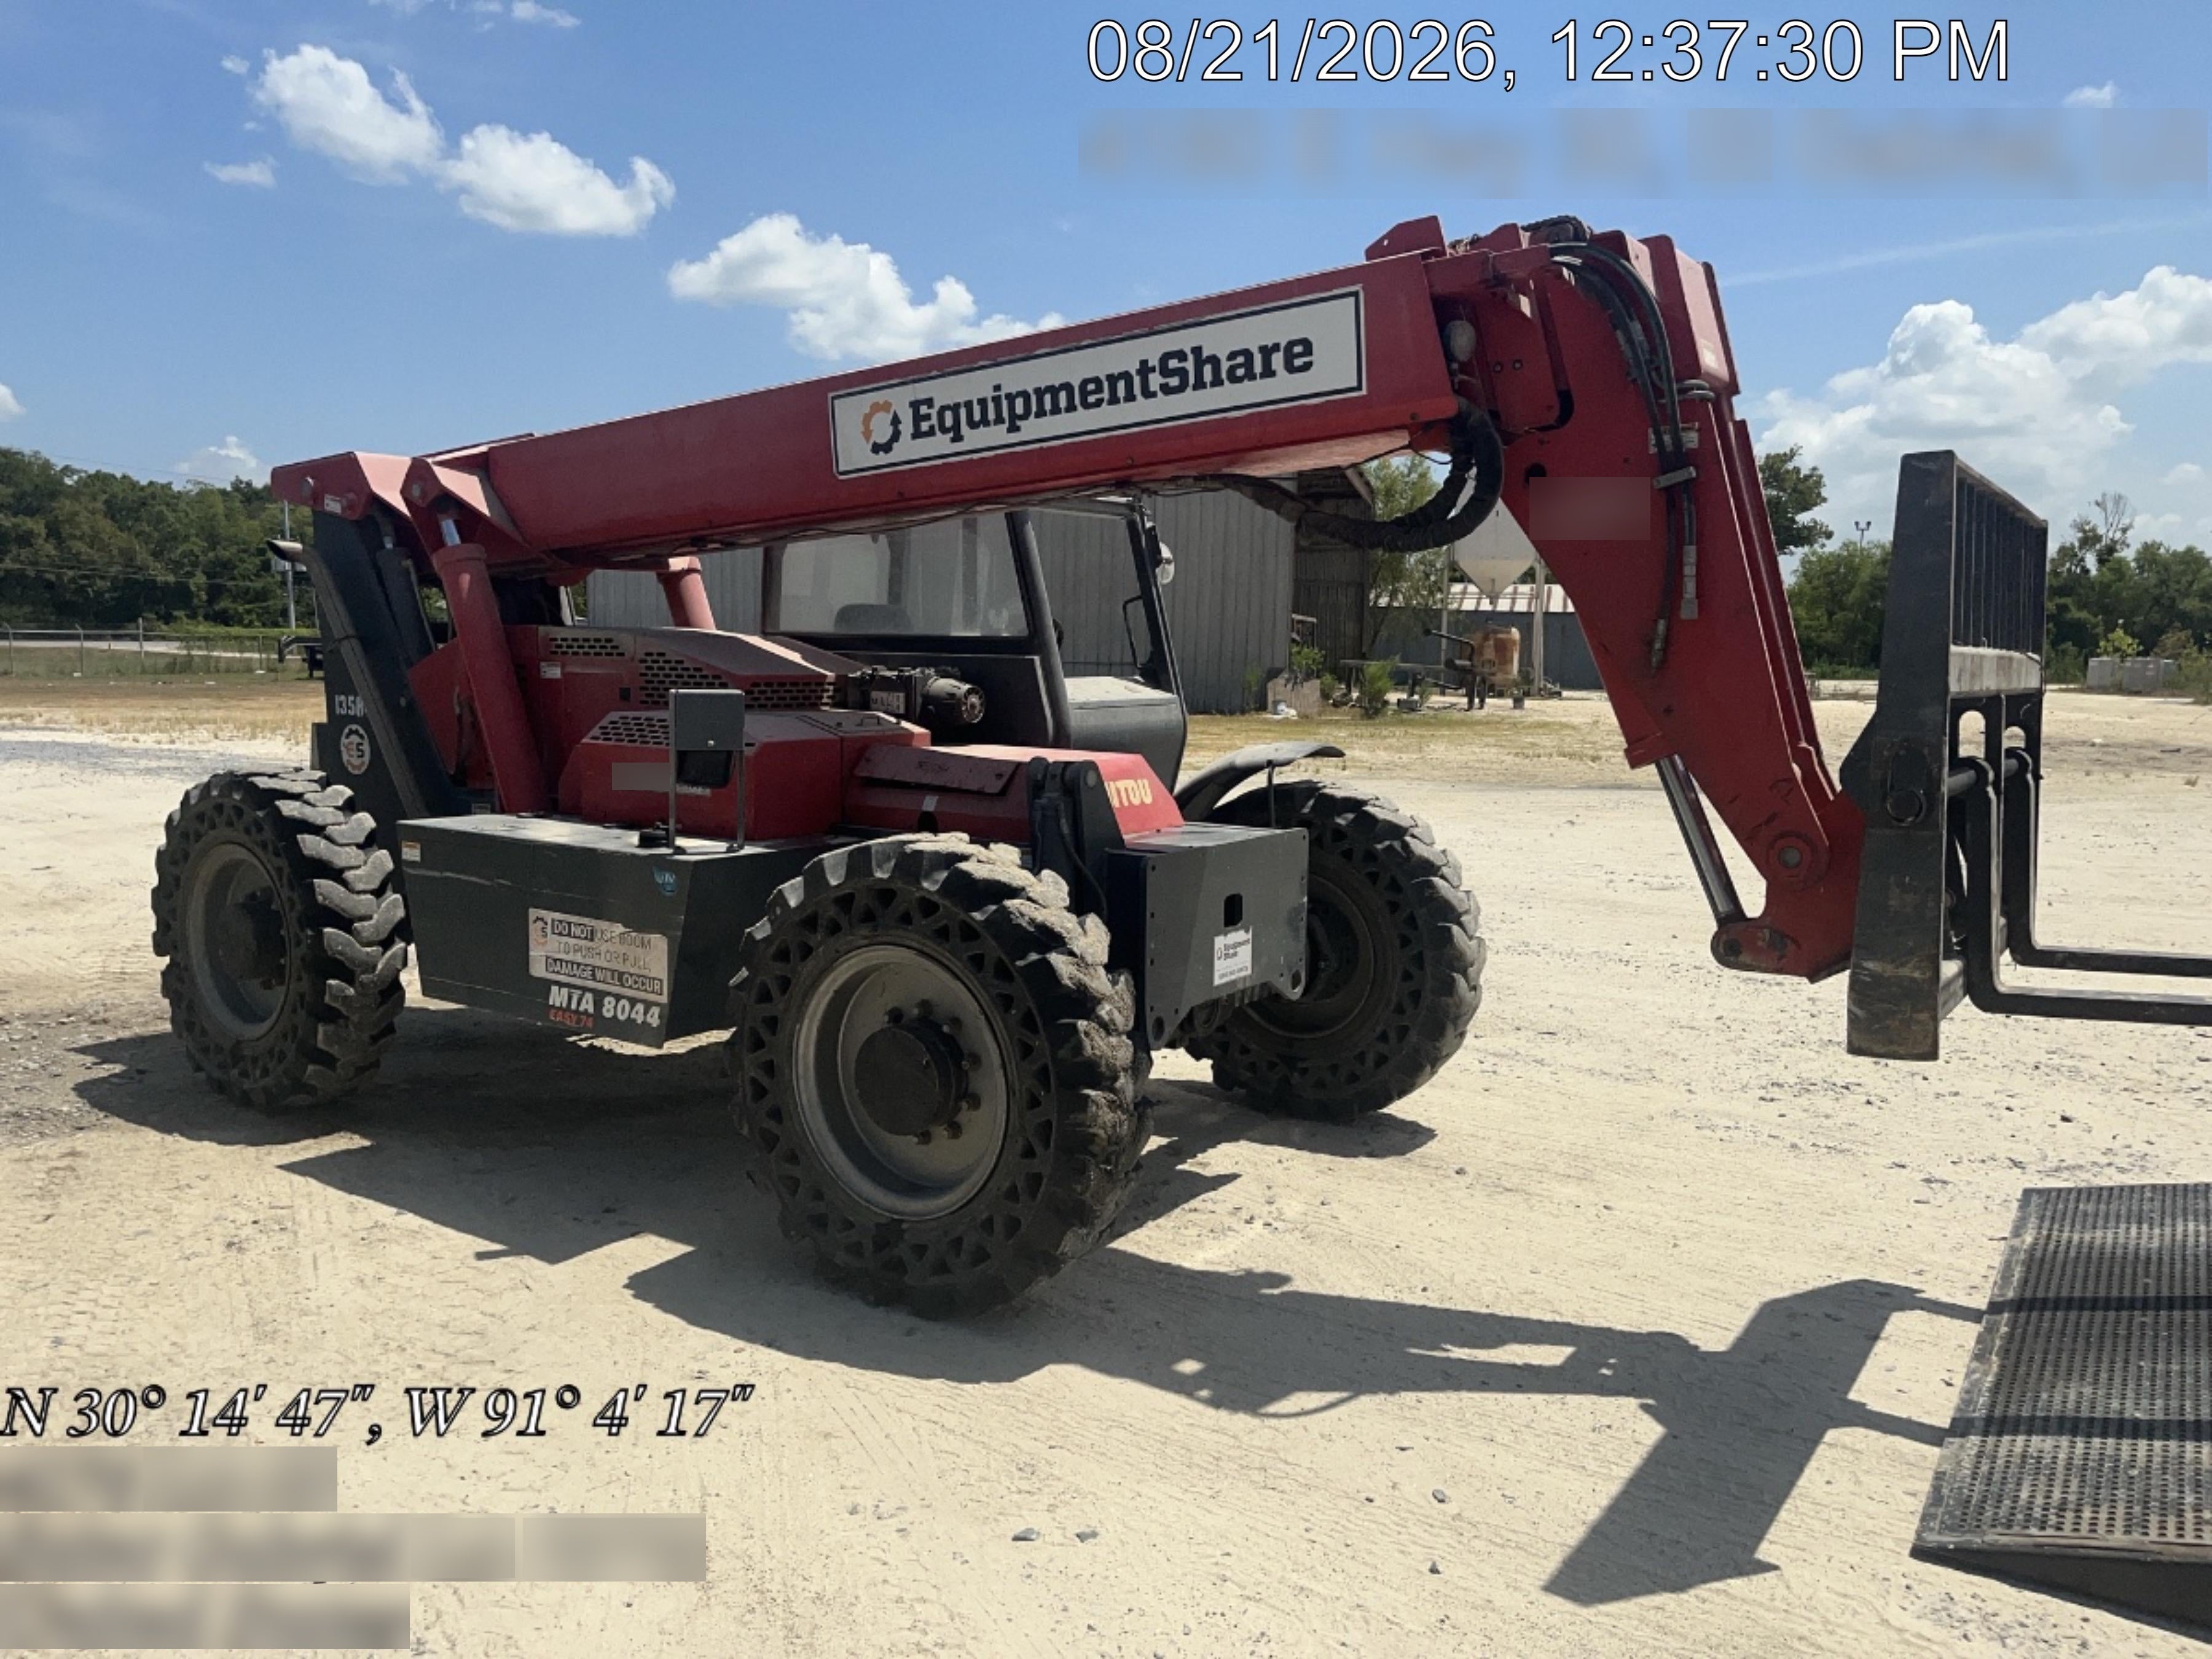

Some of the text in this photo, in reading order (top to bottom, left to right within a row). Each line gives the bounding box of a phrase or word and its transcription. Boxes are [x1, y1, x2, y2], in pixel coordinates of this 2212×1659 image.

[909, 337, 1313, 444] EquipmentShare
[554, 922, 651, 949] DO NOT USE BOOM
[558, 941, 570, 955] TO
[573, 943, 602, 960] PUSH
[604, 949, 620, 964] OR
[547, 958, 662, 995] DAMAGE WILL OCCUR
[548, 985, 661, 1028] MTA 8044
[549, 1008, 576, 1026] EASY
